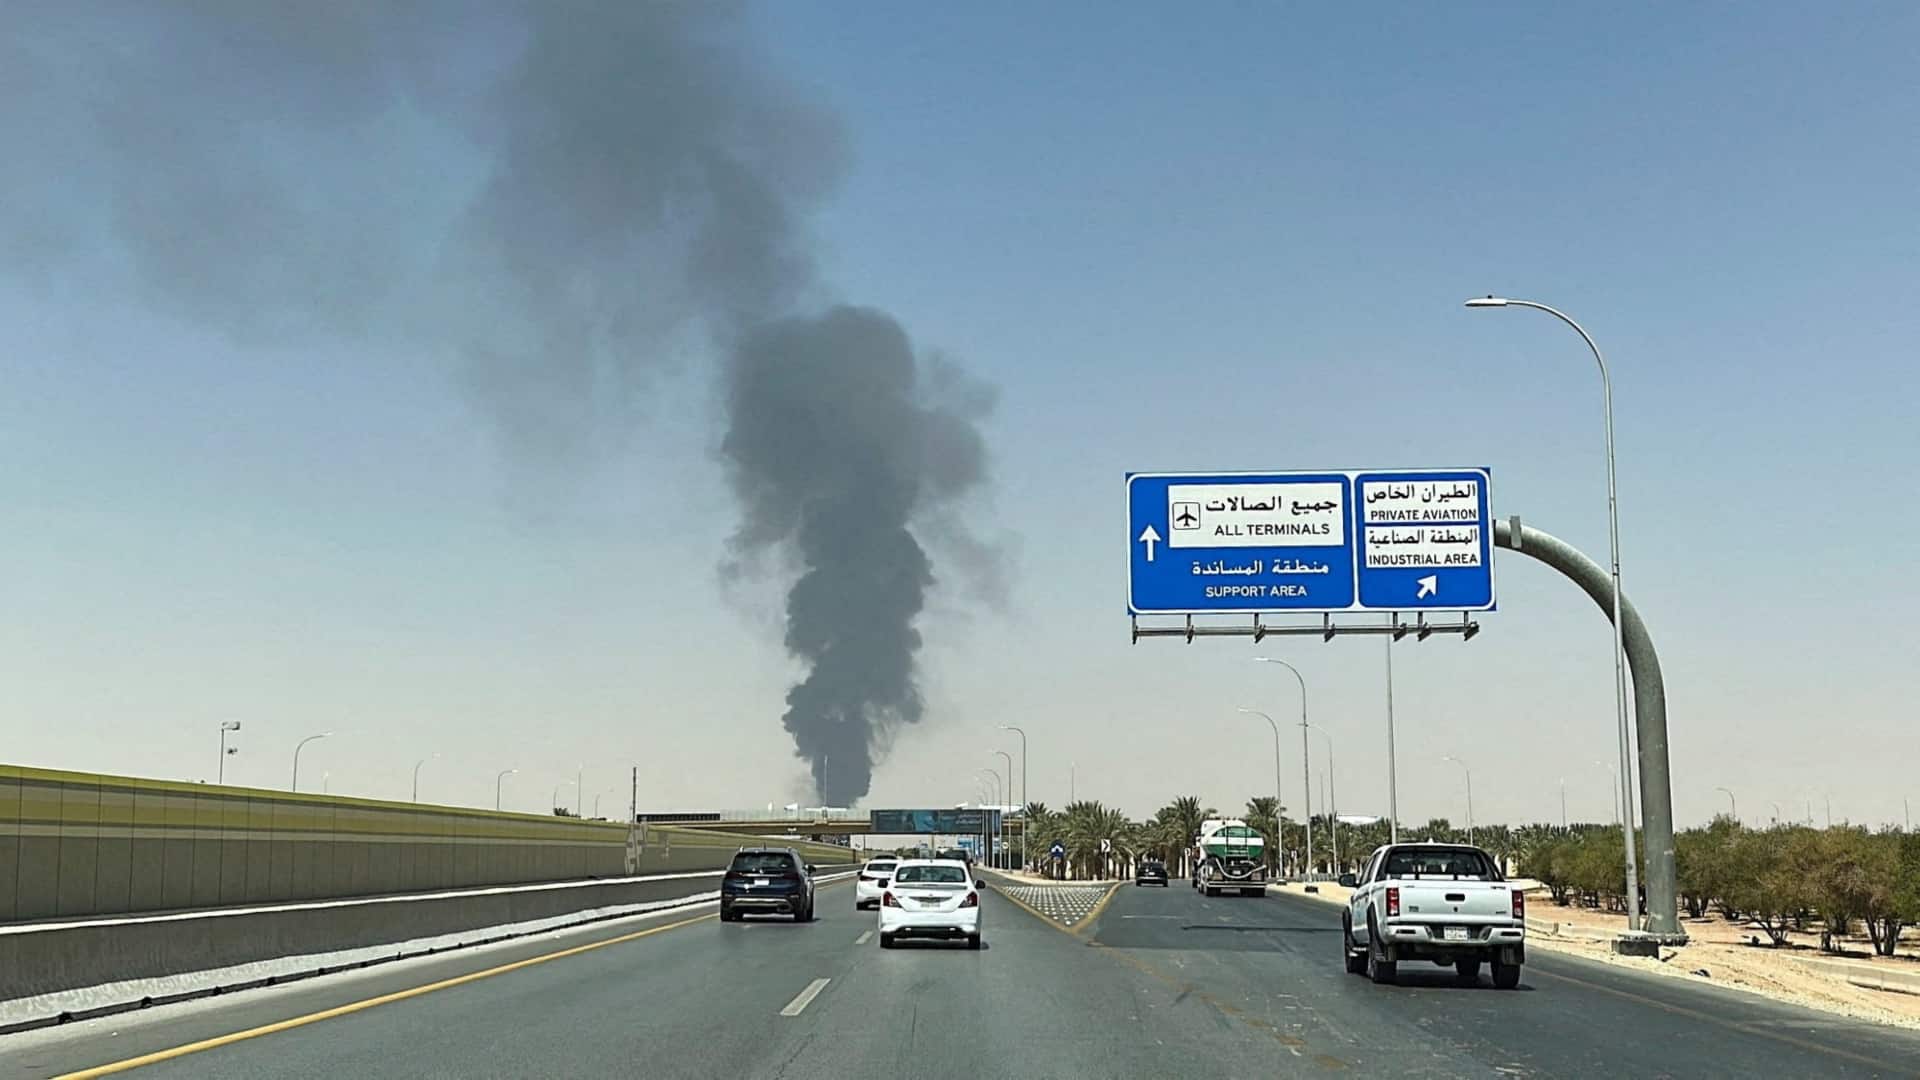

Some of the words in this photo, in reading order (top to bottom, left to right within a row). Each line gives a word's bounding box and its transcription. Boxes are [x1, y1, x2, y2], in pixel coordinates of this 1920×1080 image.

[1366, 484, 1415, 503] الخاص
[1421, 483, 1476, 503] الطيران
[1205, 495, 1282, 512] الصالات
[1290, 498, 1338, 515] جميع
[1370, 509, 1419, 520] PRIVATE
[1422, 508, 1477, 520] AVIATION
[1214, 524, 1243, 536] ALL
[1247, 523, 1330, 536] TERMINALS
[1430, 528, 1478, 546] المنطقة
[1368, 529, 1425, 549] الصناعية
[1192, 559, 1263, 576] المساندة
[1272, 557, 1329, 575] منطقة
[1368, 554, 1441, 565] INDUSTRIAL
[1443, 553, 1478, 564] AREA
[1206, 585, 1266, 598] SUPPORT
[1270, 584, 1307, 597] AREA
